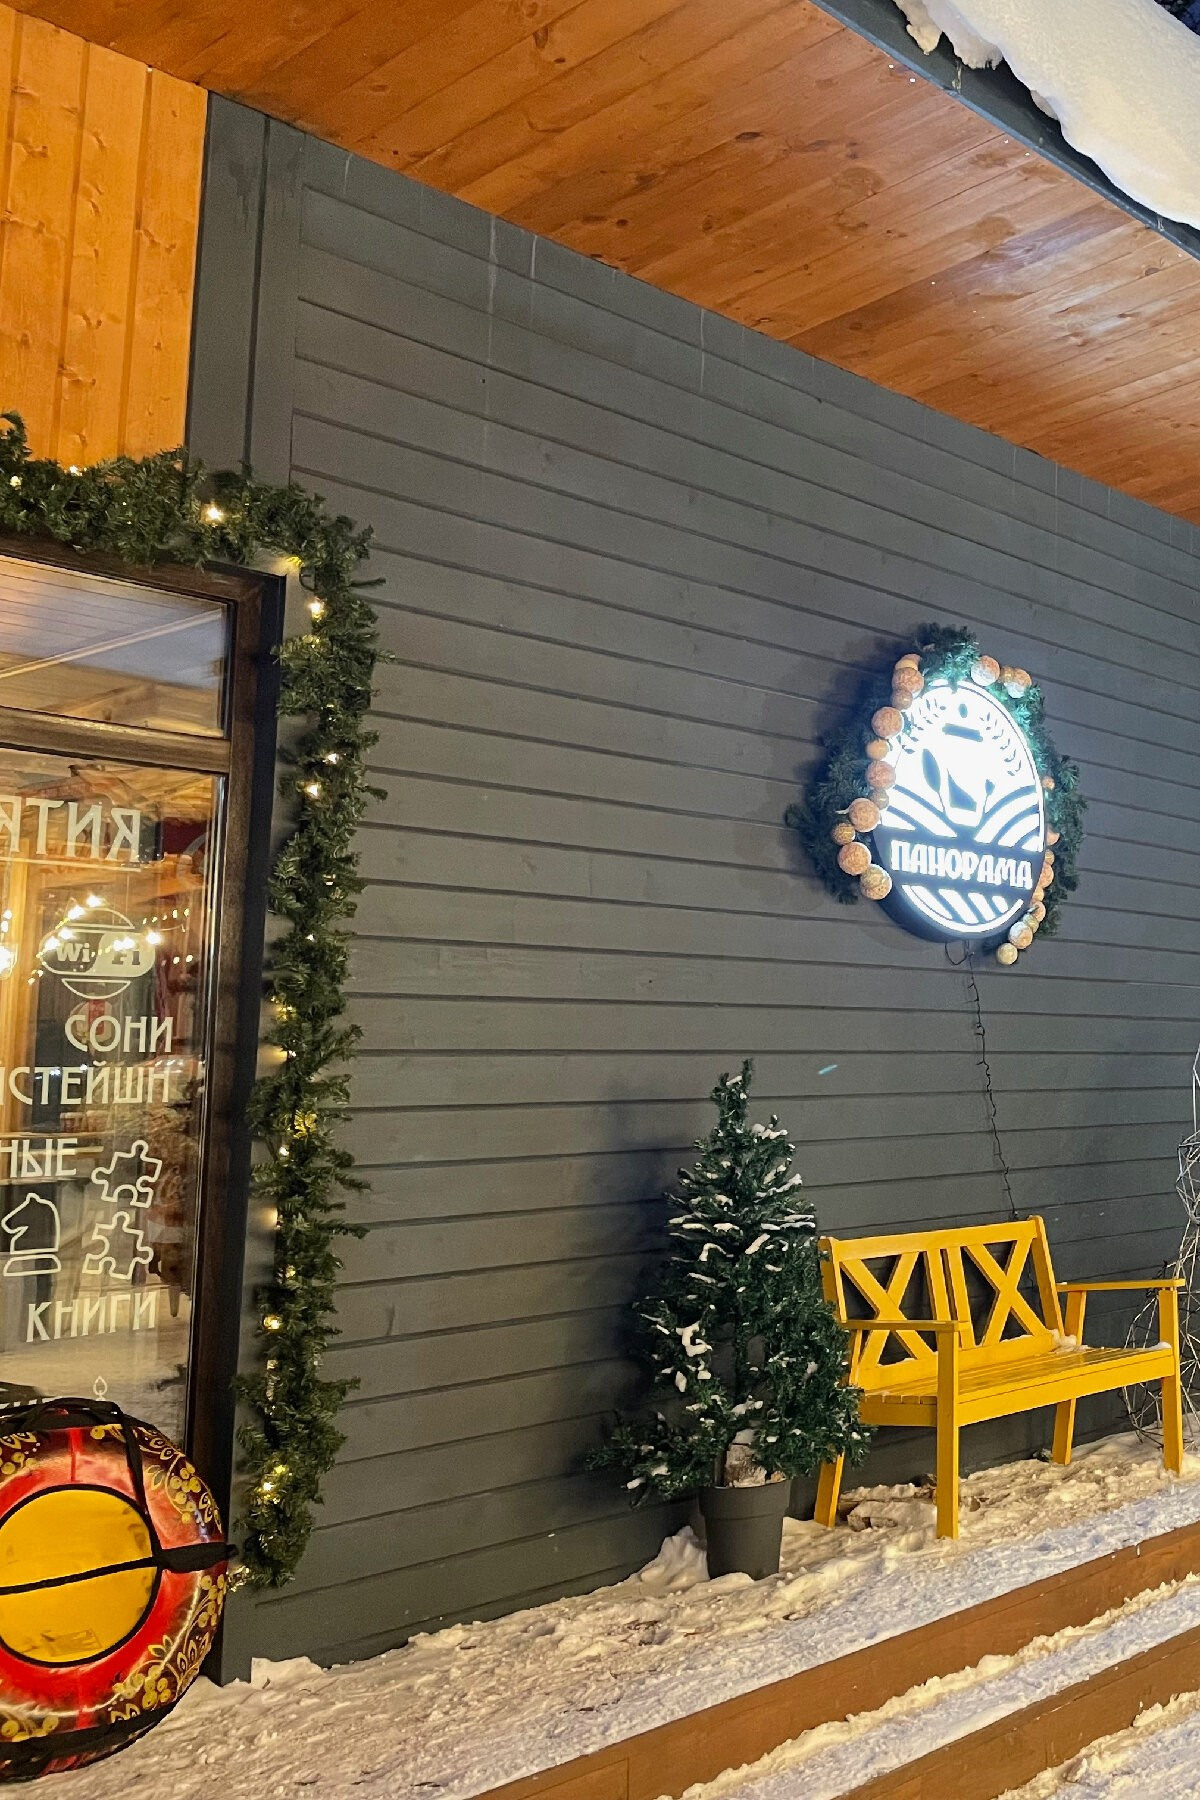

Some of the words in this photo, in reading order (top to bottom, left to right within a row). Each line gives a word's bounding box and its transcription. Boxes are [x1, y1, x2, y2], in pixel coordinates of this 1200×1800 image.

[890, 840, 1033, 890] ПАНОРАМА
[64, 1014, 174, 1053] СОНИ
[0, 1060, 170, 1105] СТЕЙШН
[26, 1291, 157, 1343] КНИГИ
